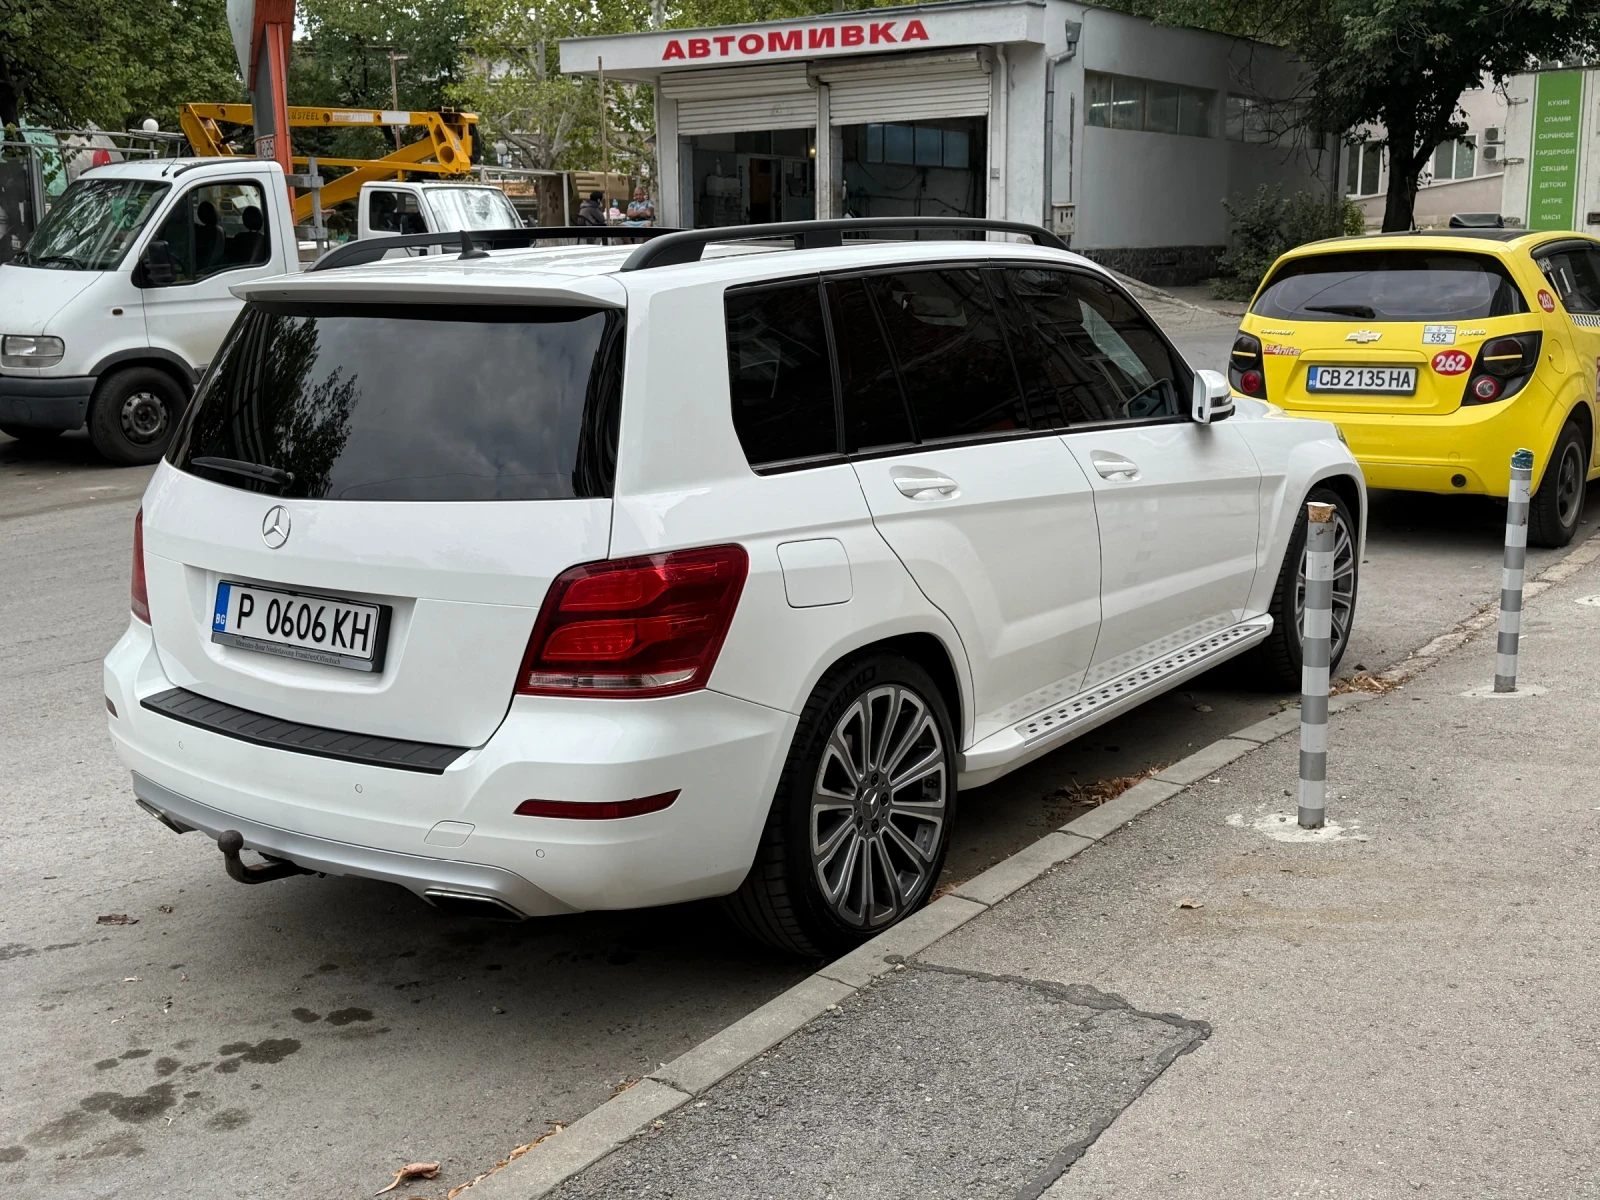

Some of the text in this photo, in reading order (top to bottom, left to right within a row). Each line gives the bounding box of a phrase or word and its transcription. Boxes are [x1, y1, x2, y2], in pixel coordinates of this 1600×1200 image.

[662, 19, 929, 60] АВТОМИВКА
[1543, 115, 1572, 123] СПАЛНИ
[1538, 132, 1575, 140] СКРИНОВЕ
[1535, 148, 1575, 156] ГАРДЕРОБИ
[1539, 181, 1567, 189] ДЕТСКИ
[1541, 197, 1563, 205] АНТРЕ
[1538, 293, 1554, 309] 262
[1430, 333, 1447, 343] 552
[1435, 354, 1467, 372] 262
[1319, 369, 1411, 389] CB 2135 HA
[215, 612, 226, 625] BG
[236, 592, 371, 652] P 0606 KH
[235, 639, 266, 652] Mercedes-Benz
